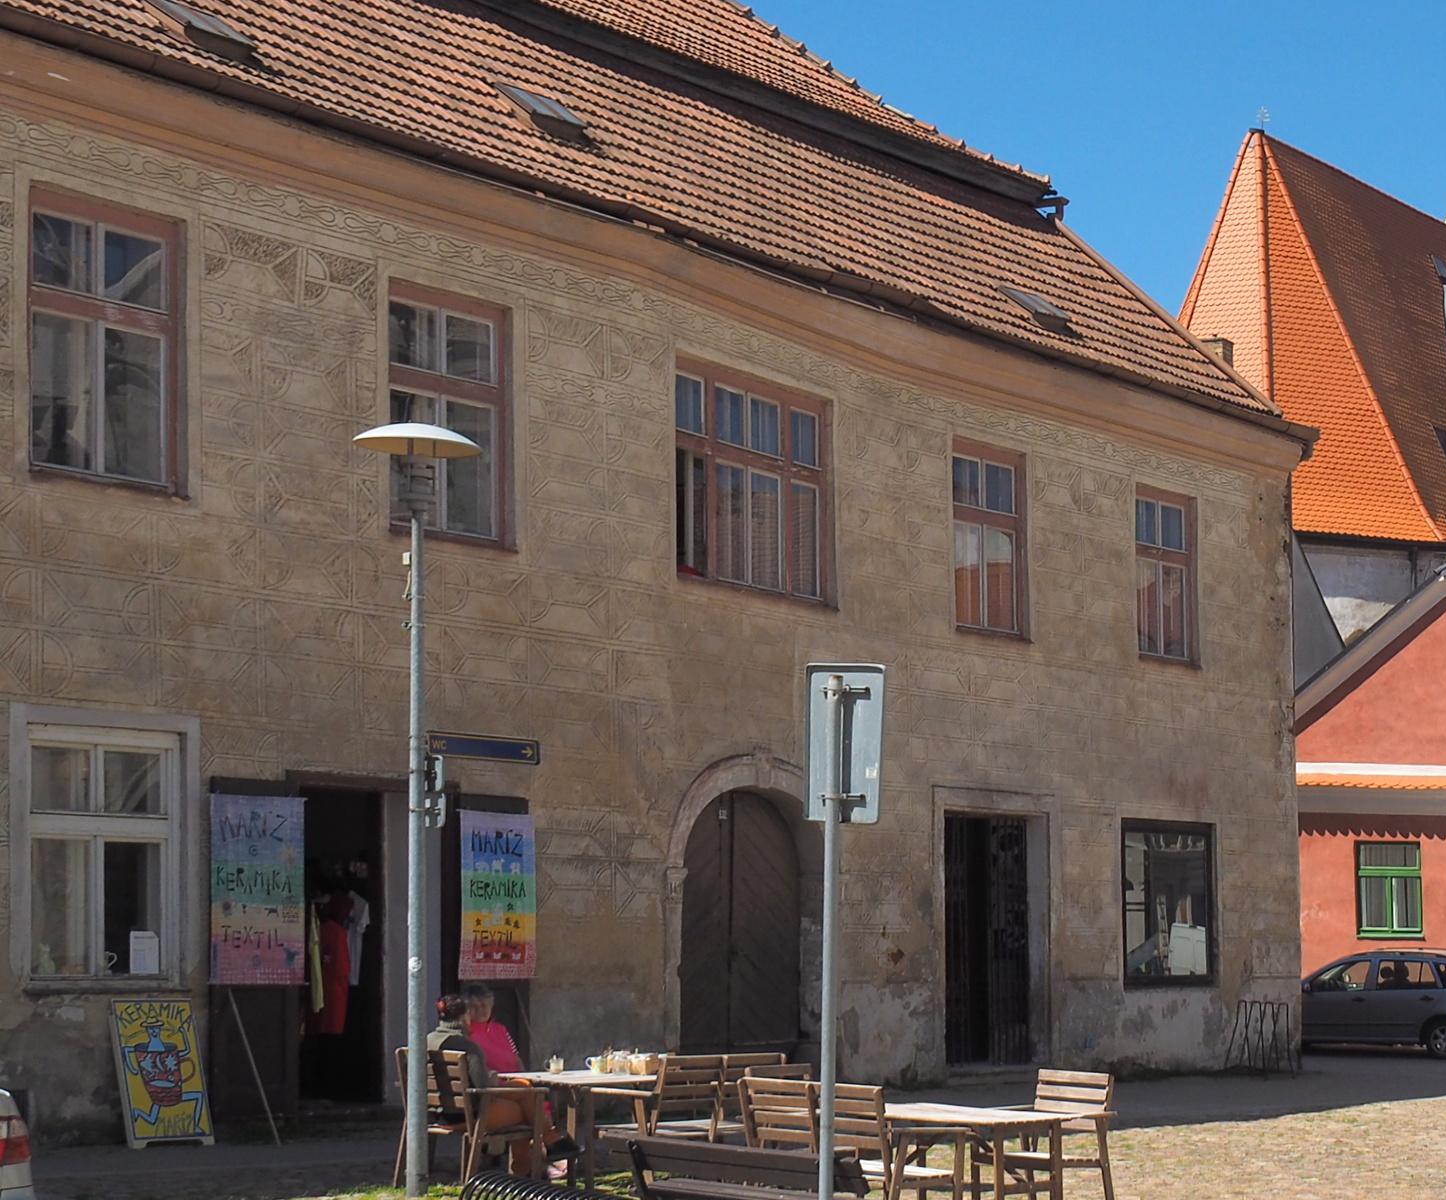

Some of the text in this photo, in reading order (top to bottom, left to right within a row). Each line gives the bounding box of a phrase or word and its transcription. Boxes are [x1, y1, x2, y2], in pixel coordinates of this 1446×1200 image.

[431, 738, 447, 751] WC
[217, 866, 292, 896] KERAMIKA
[470, 879, 527, 901] KERAMIKA
[221, 924, 284, 950] TEXTIL
[472, 929, 518, 950] TEXTIL
[119, 1002, 192, 1032] KERAMIKA
